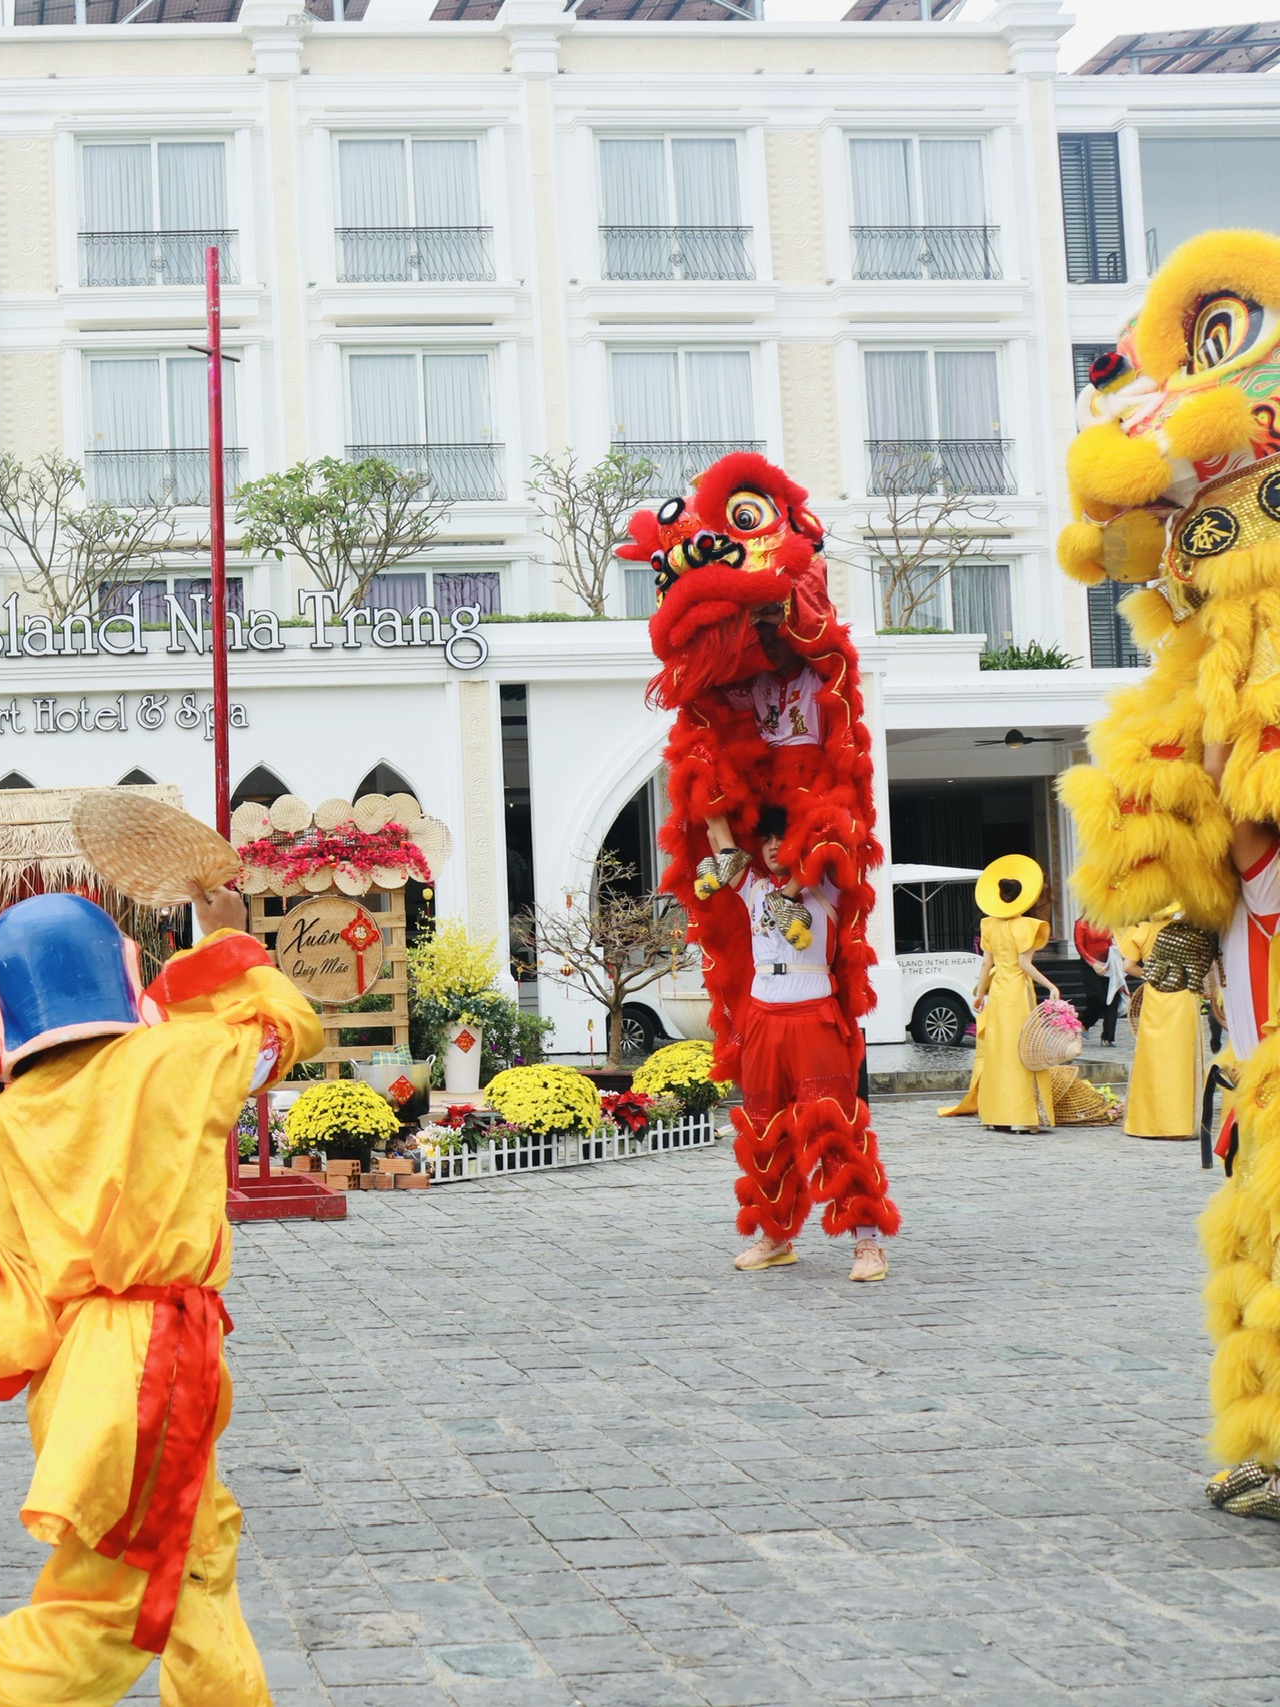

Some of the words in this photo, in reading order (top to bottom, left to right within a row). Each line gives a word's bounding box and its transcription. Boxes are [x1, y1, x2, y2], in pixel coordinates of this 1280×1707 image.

[164, 593, 286, 656] Nha
[298, 588, 489, 670] Trang
[33, 694, 128, 734] Hotel
[136, 694, 169, 730] &
[283, 917, 340, 955] Xuân
[292, 959, 318, 983] Quý
[897, 960, 923, 968] SLAND
[951, 957, 977, 965] HEART
[925, 966, 942, 974] CITY
